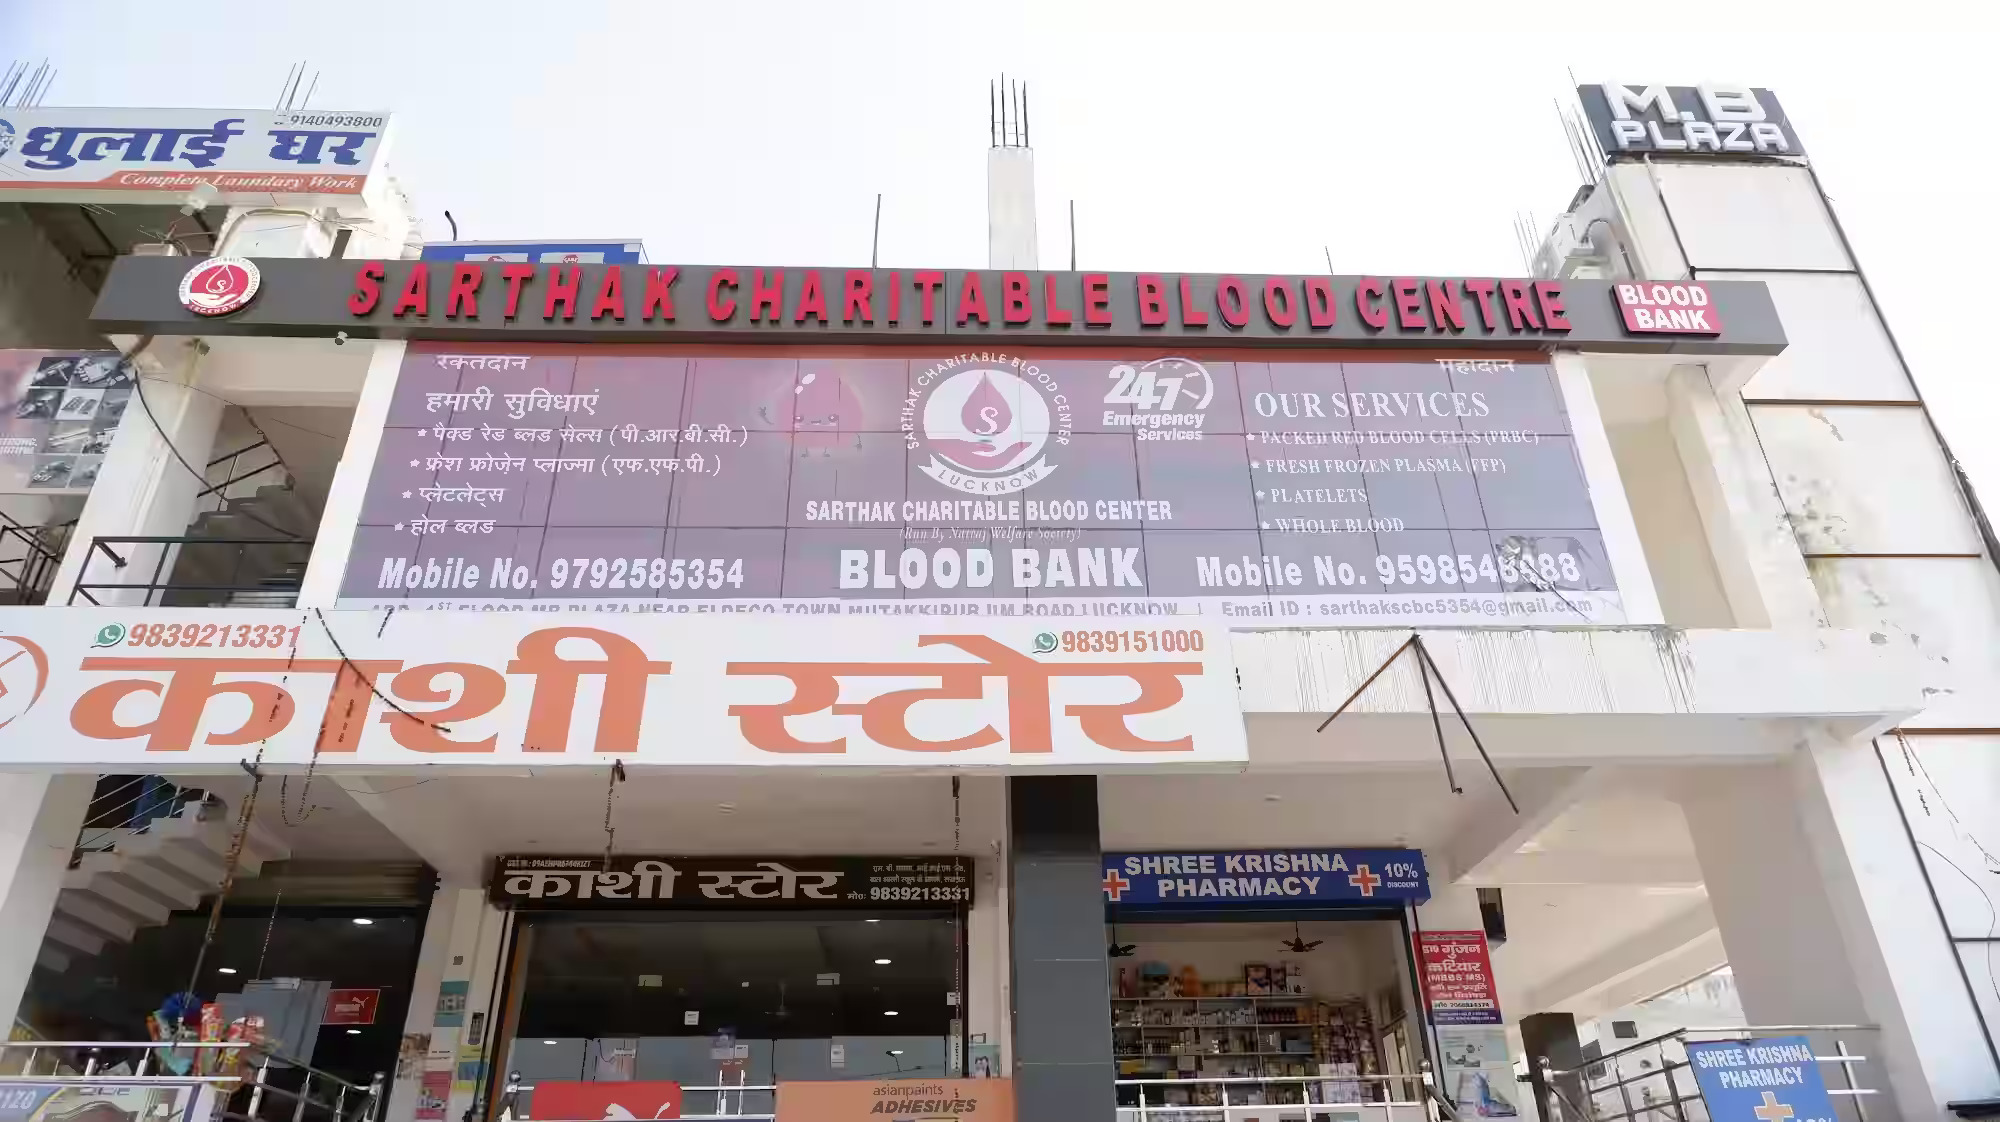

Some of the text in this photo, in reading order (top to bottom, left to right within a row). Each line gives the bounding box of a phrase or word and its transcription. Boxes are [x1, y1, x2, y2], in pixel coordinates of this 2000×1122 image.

[1602, 81, 1767, 123] M.B
[20, 119, 376, 170] धुलाई घर
[1611, 120, 1789, 150] PLAZA
[308, 175, 357, 189] Work
[348, 261, 1572, 333] SARTHAK CHARITABLE BLOOD CENTRE
[1618, 285, 1708, 306] BLOOD
[1633, 308, 1711, 330] BANK
[425, 386, 600, 420] हमारी सुविधाएं
[901, 352, 1072, 449] SARTHAK CHARITABLE BLOOD CENTER
[1254, 391, 1490, 418] OUR SERVICES
[975, 407, 999, 434] S
[1102, 411, 1206, 428] Emergency
[432, 421, 475, 441] पैक्ड
[480, 422, 507, 441] रेड
[513, 428, 554, 442] ब्लड
[558, 424, 603, 443] सेल्स
[1137, 428, 1203, 441] Services
[1260, 430, 1539, 446] PACKED RED BLOOD CELLS (PRBC)
[425, 452, 464, 471] फ्रेश
[532, 458, 596, 473] प्लाज्मा
[601, 453, 721, 477] (एफ.एफ.पी.)
[1266, 459, 1321, 473] FRESH
[1324, 459, 1391, 473] FROZEN
[1394, 458, 1463, 472] PLASMA
[937, 469, 1038, 492] LUCKNOW
[419, 481, 507, 508] प्लेटलेट्स
[1271, 488, 1368, 503] PLATELETS
[806, 500, 1173, 522] SARTHAK CHARITABLE BLOOD CENTER
[411, 514, 496, 536] होल ब्लड
[931, 526, 944, 543] By
[1275, 517, 1405, 533] WHOLE BLOOD
[377, 558, 744, 589] Mobile No. 9792585354
[839, 547, 1143, 589] BLOOD BANK
[1195, 556, 1302, 587] Mobile
[1313, 556, 1366, 587] No.
[1221, 601, 1273, 616] Email
[1279, 600, 1299, 616] ID
[128, 623, 300, 648] 9839213331
[1062, 630, 1204, 653] 9839151000
[70, 627, 1204, 753] काशी स्टोर
[1124, 853, 1349, 876] SHREE KRISHNA
[1384, 863, 1418, 879] 10%
[504, 860, 844, 899] काशी स्टोर
[1157, 877, 1321, 898] PHARMACY
[870, 886, 969, 901] 9839213331
[1695, 1045, 1814, 1069] SHREE KRISHNA
[1719, 1066, 1804, 1089] PHARMACY
[872, 1083, 944, 1100] asianpaints
[870, 1099, 978, 1115] ADHESIVES
